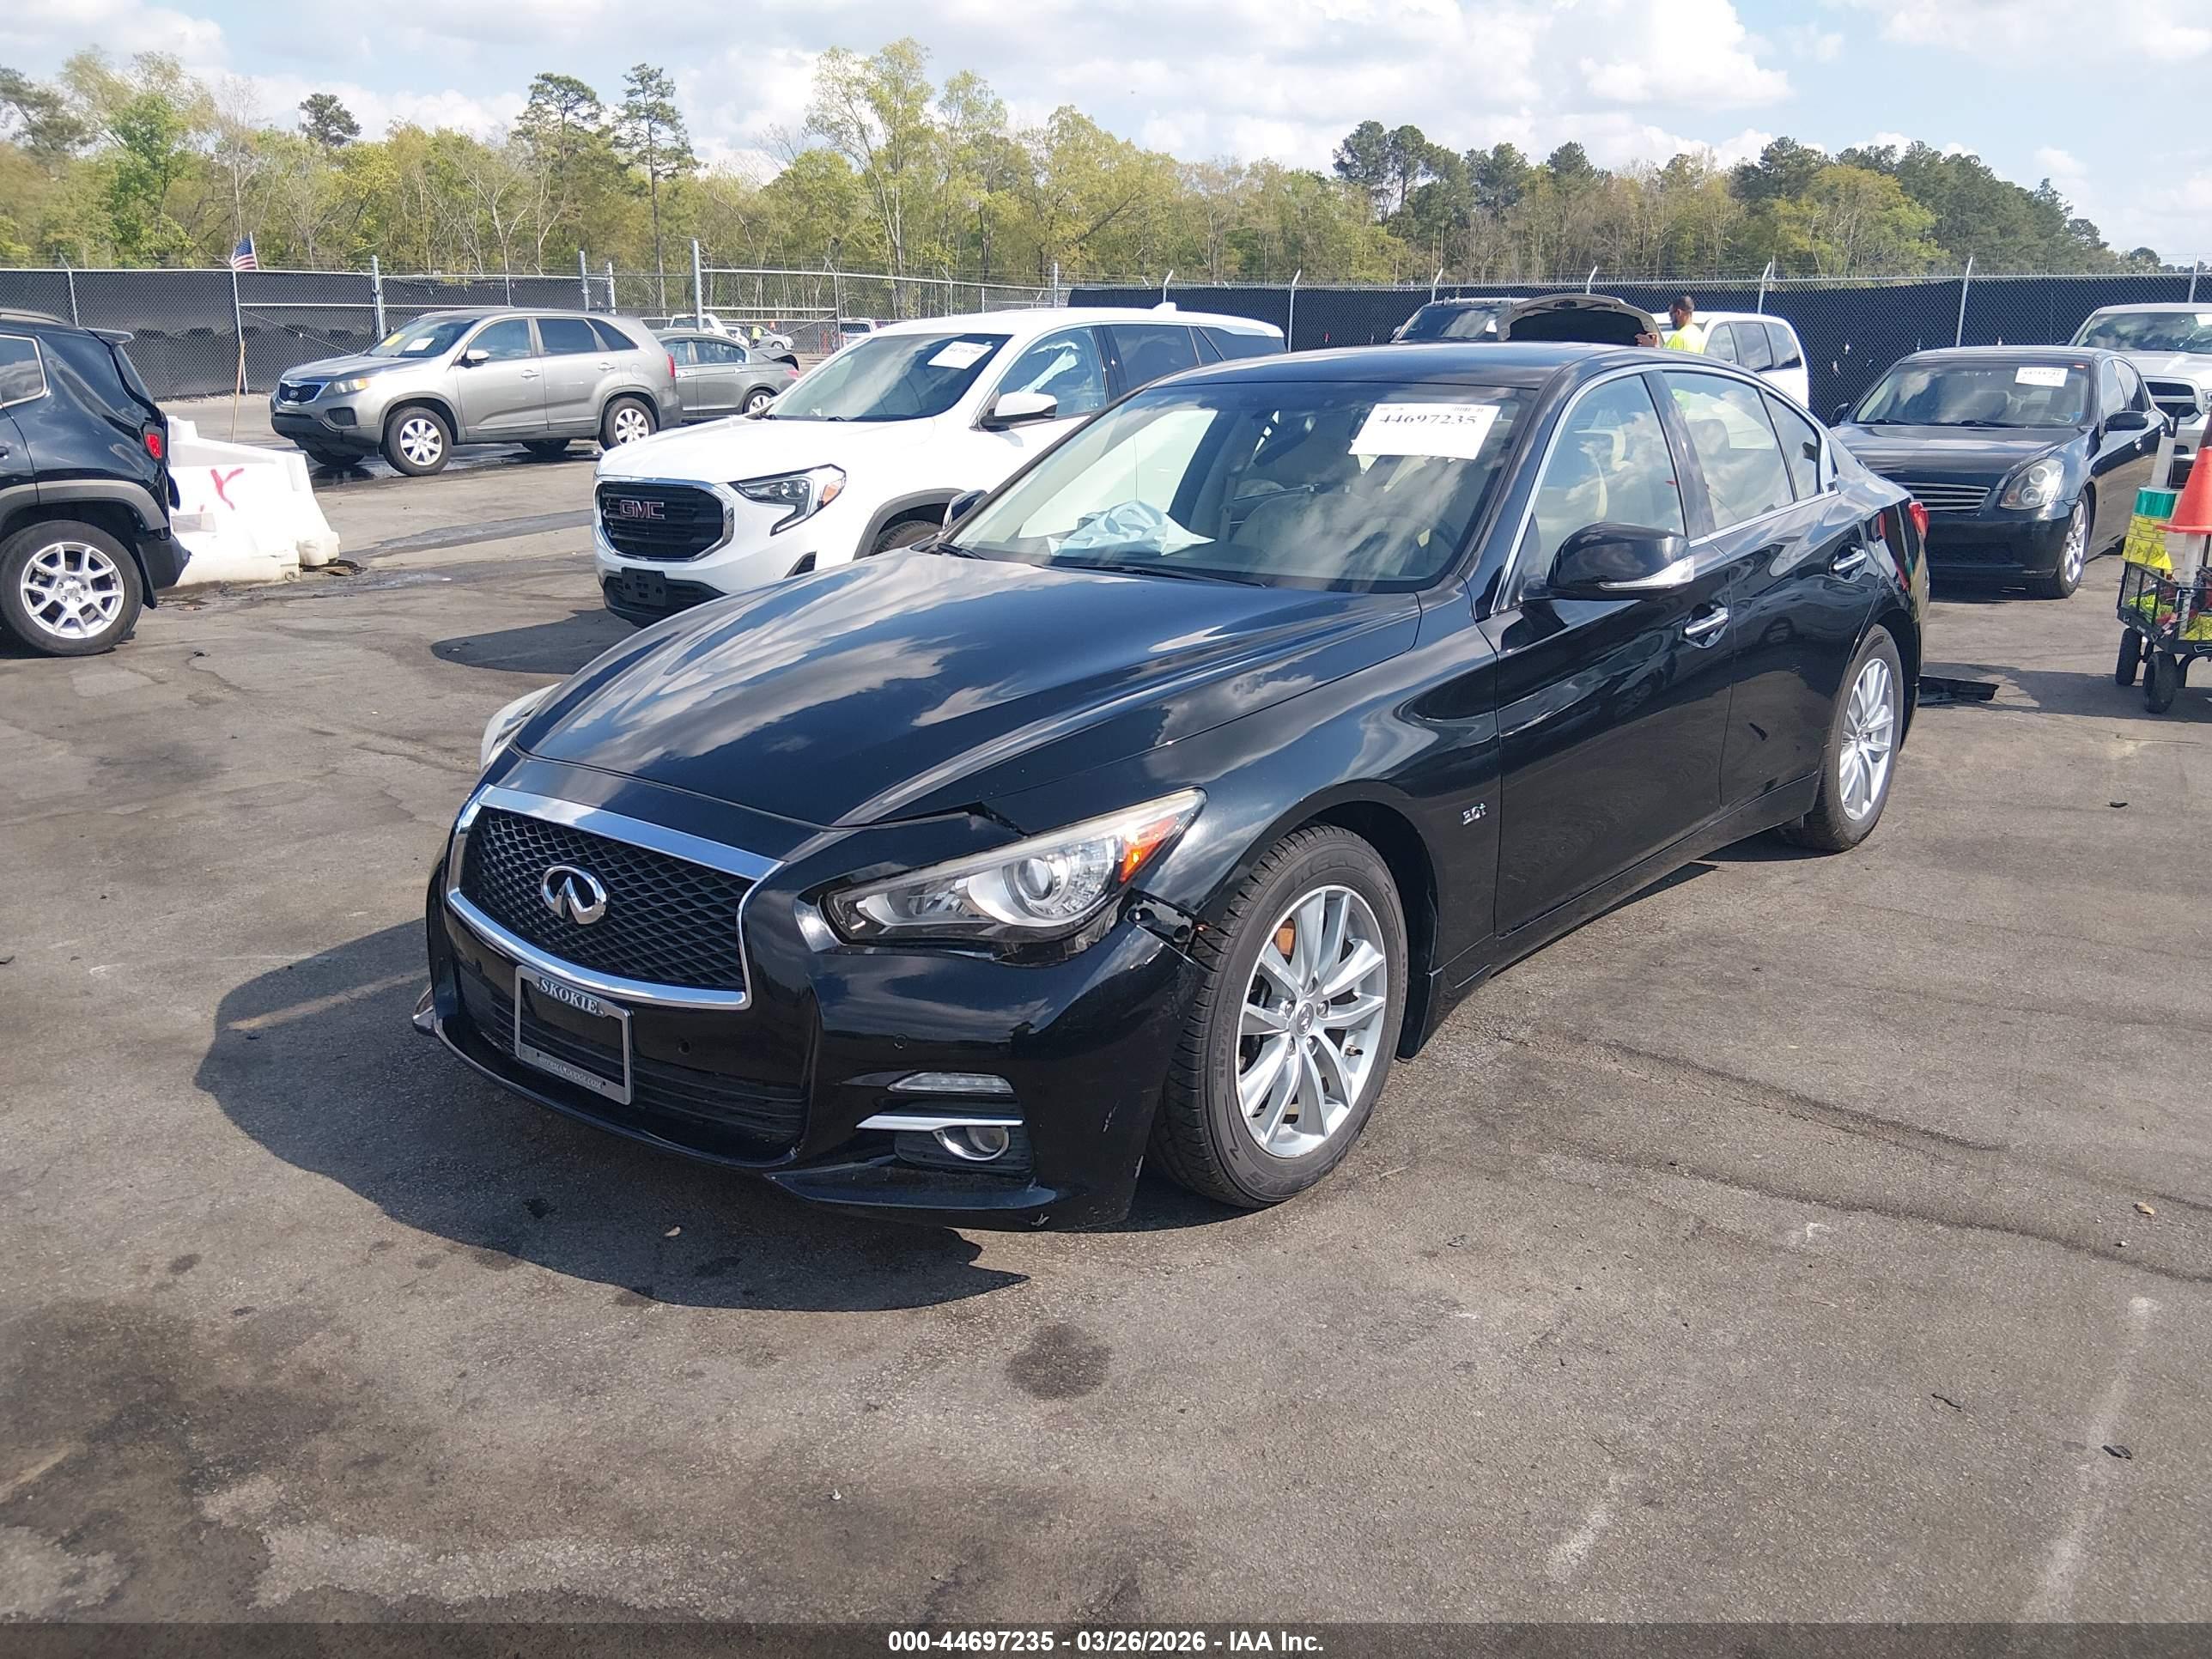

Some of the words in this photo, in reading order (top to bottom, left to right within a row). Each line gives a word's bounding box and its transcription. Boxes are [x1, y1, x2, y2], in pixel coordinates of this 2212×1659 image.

[1378, 414, 1478, 425] 44697235
[619, 499, 665, 520] GMC
[541, 979, 598, 1013] SKOKIE
